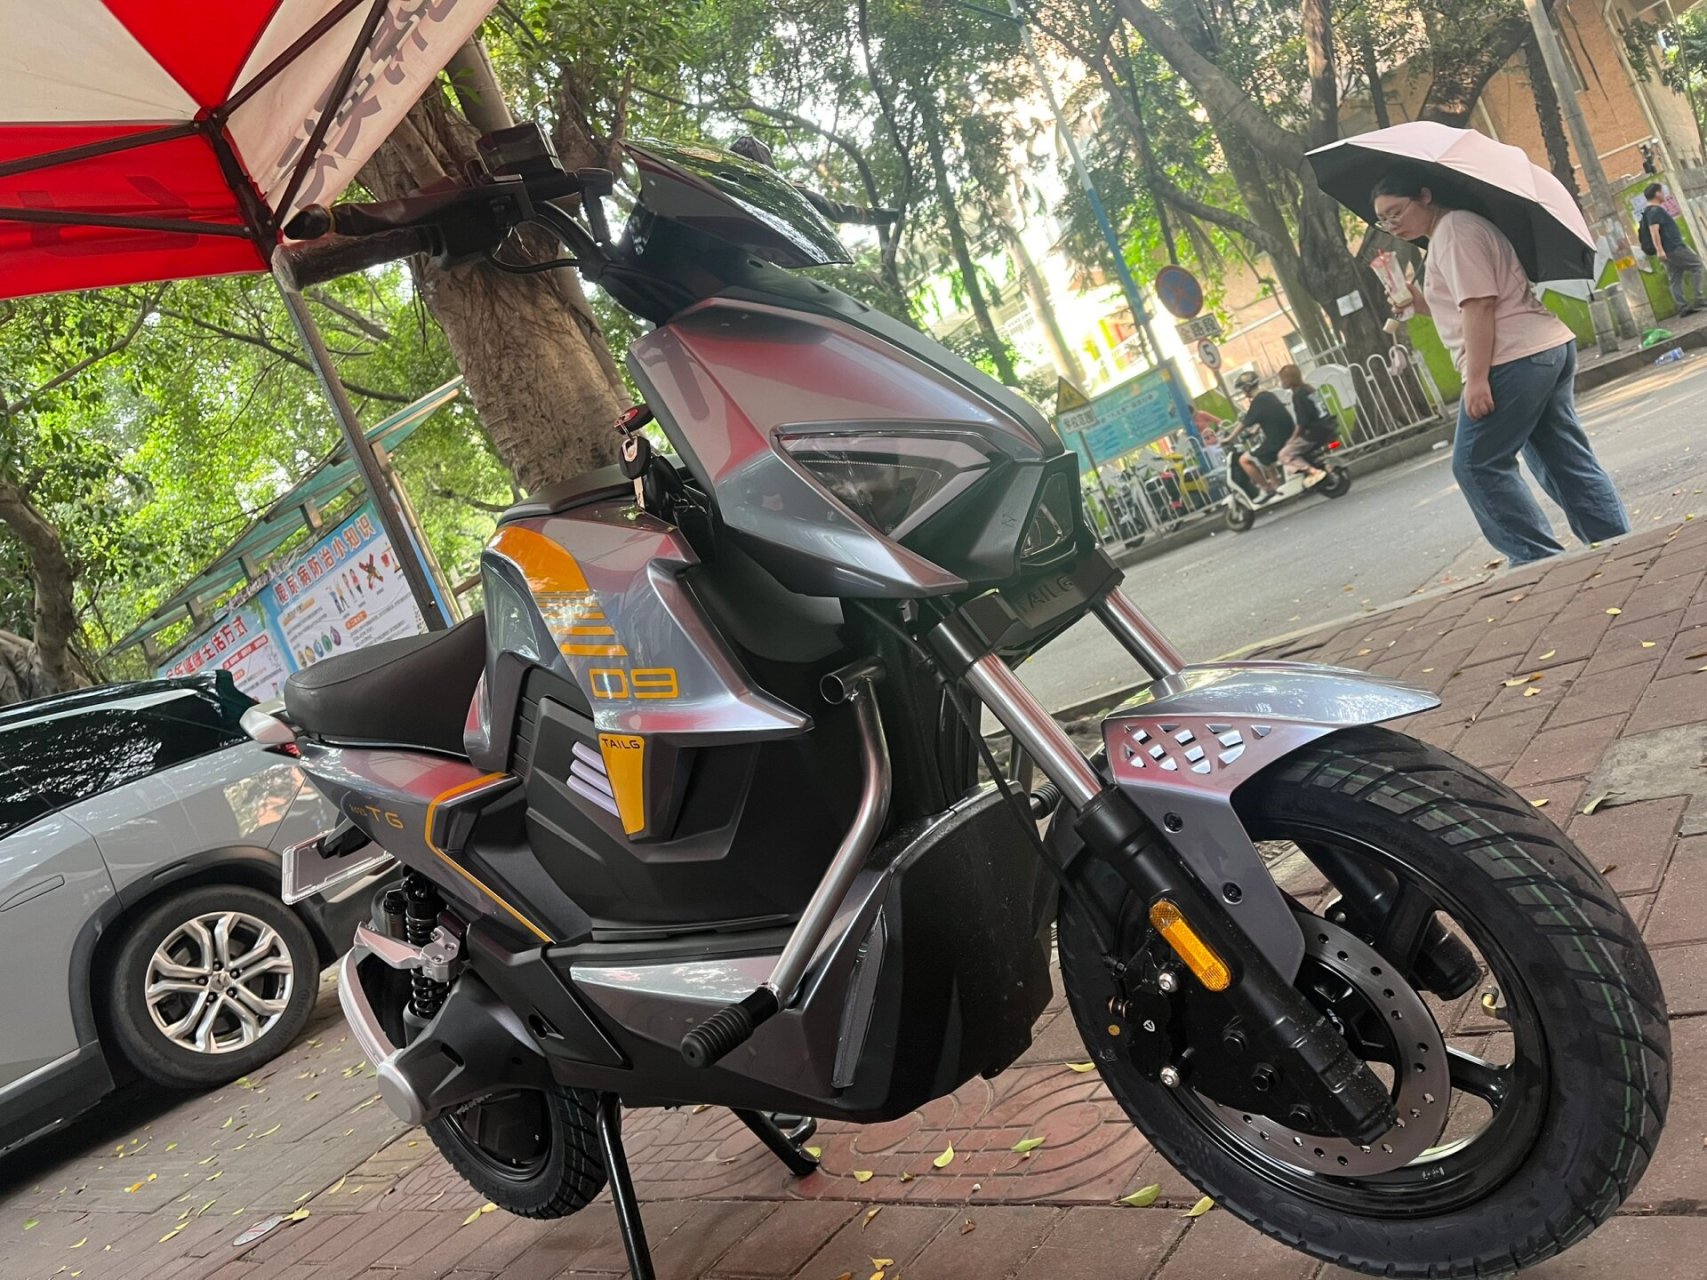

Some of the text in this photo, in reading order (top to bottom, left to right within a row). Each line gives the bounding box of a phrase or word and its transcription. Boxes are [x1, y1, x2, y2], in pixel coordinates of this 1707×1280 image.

[1202, 344, 1217, 365] 5
[273, 513, 376, 604] 糖尿病防治小知识
[588, 667, 679, 699] 09
[601, 737, 641, 750] TAILG
